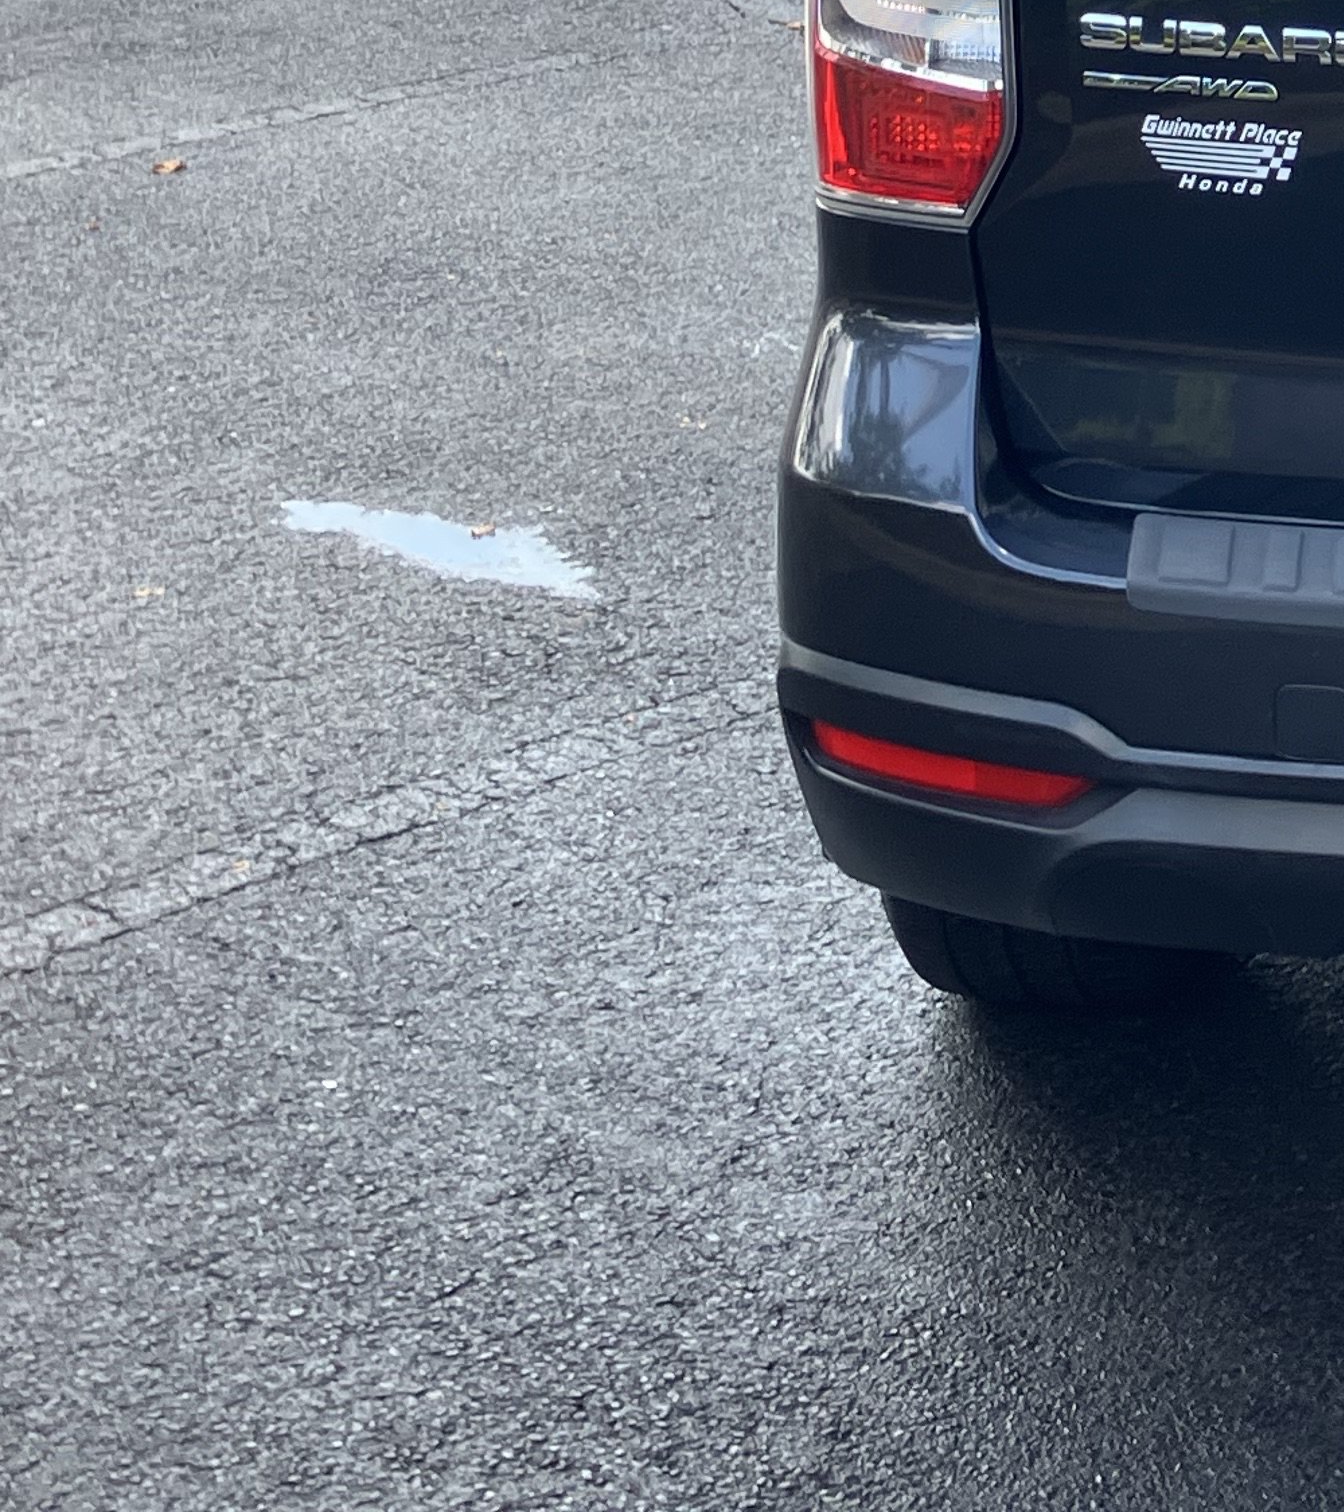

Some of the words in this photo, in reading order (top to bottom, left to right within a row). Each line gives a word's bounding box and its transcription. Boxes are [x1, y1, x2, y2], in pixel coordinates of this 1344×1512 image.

[1153, 74, 1280, 102] AWD
[1141, 113, 1236, 143] Gwinnett
[1240, 122, 1303, 146] Place
[1179, 173, 1264, 196] Honda
